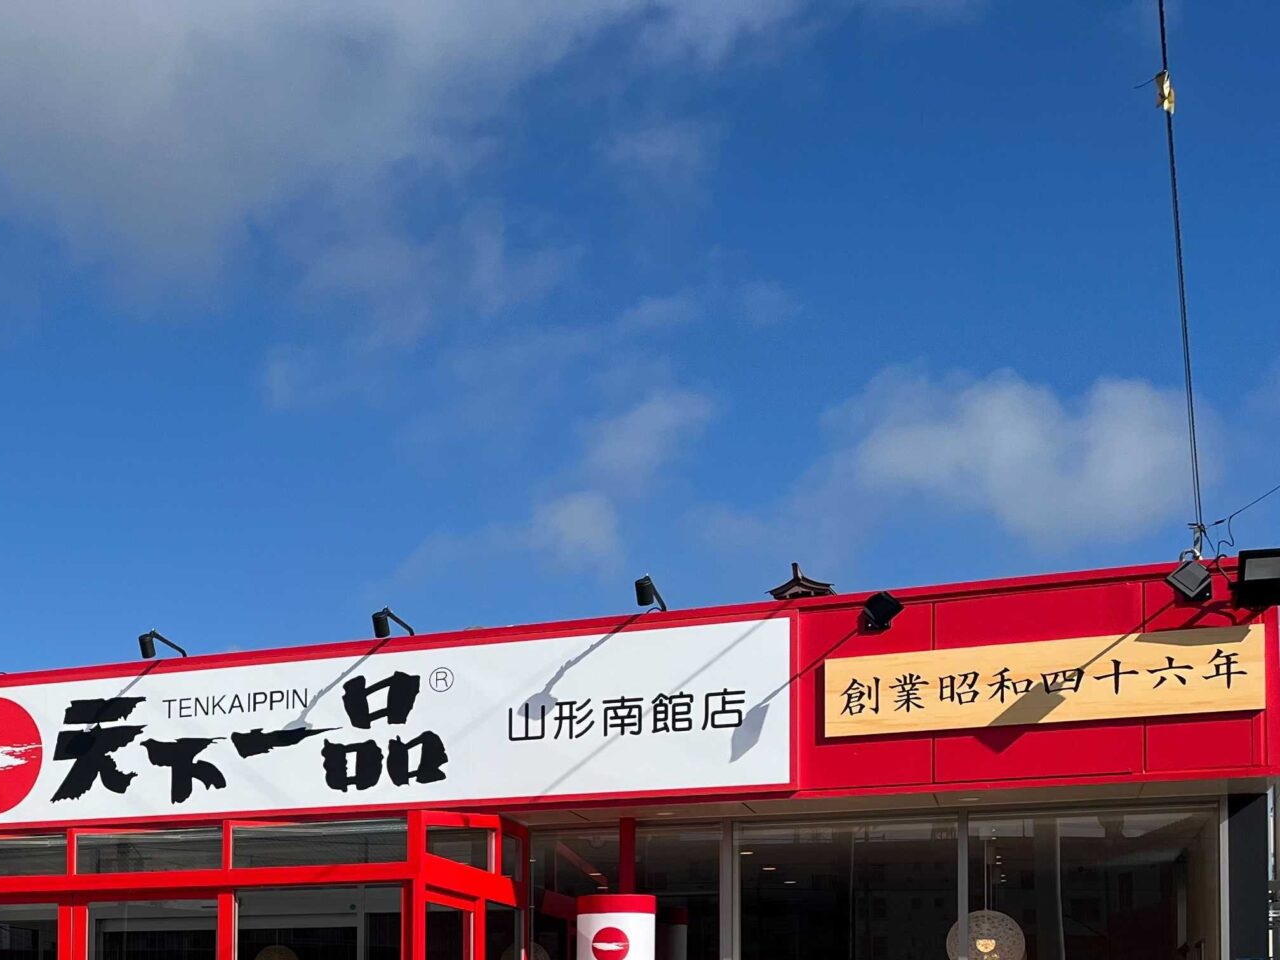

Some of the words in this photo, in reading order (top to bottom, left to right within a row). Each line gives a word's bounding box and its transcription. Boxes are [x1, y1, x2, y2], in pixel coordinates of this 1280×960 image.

[163, 688, 308, 720] TENKAIPPIN
[839, 648, 1248, 716] 創業昭和四十六年
[50, 671, 449, 805] 天下一品
[508, 688, 746, 742] 山形南館店
